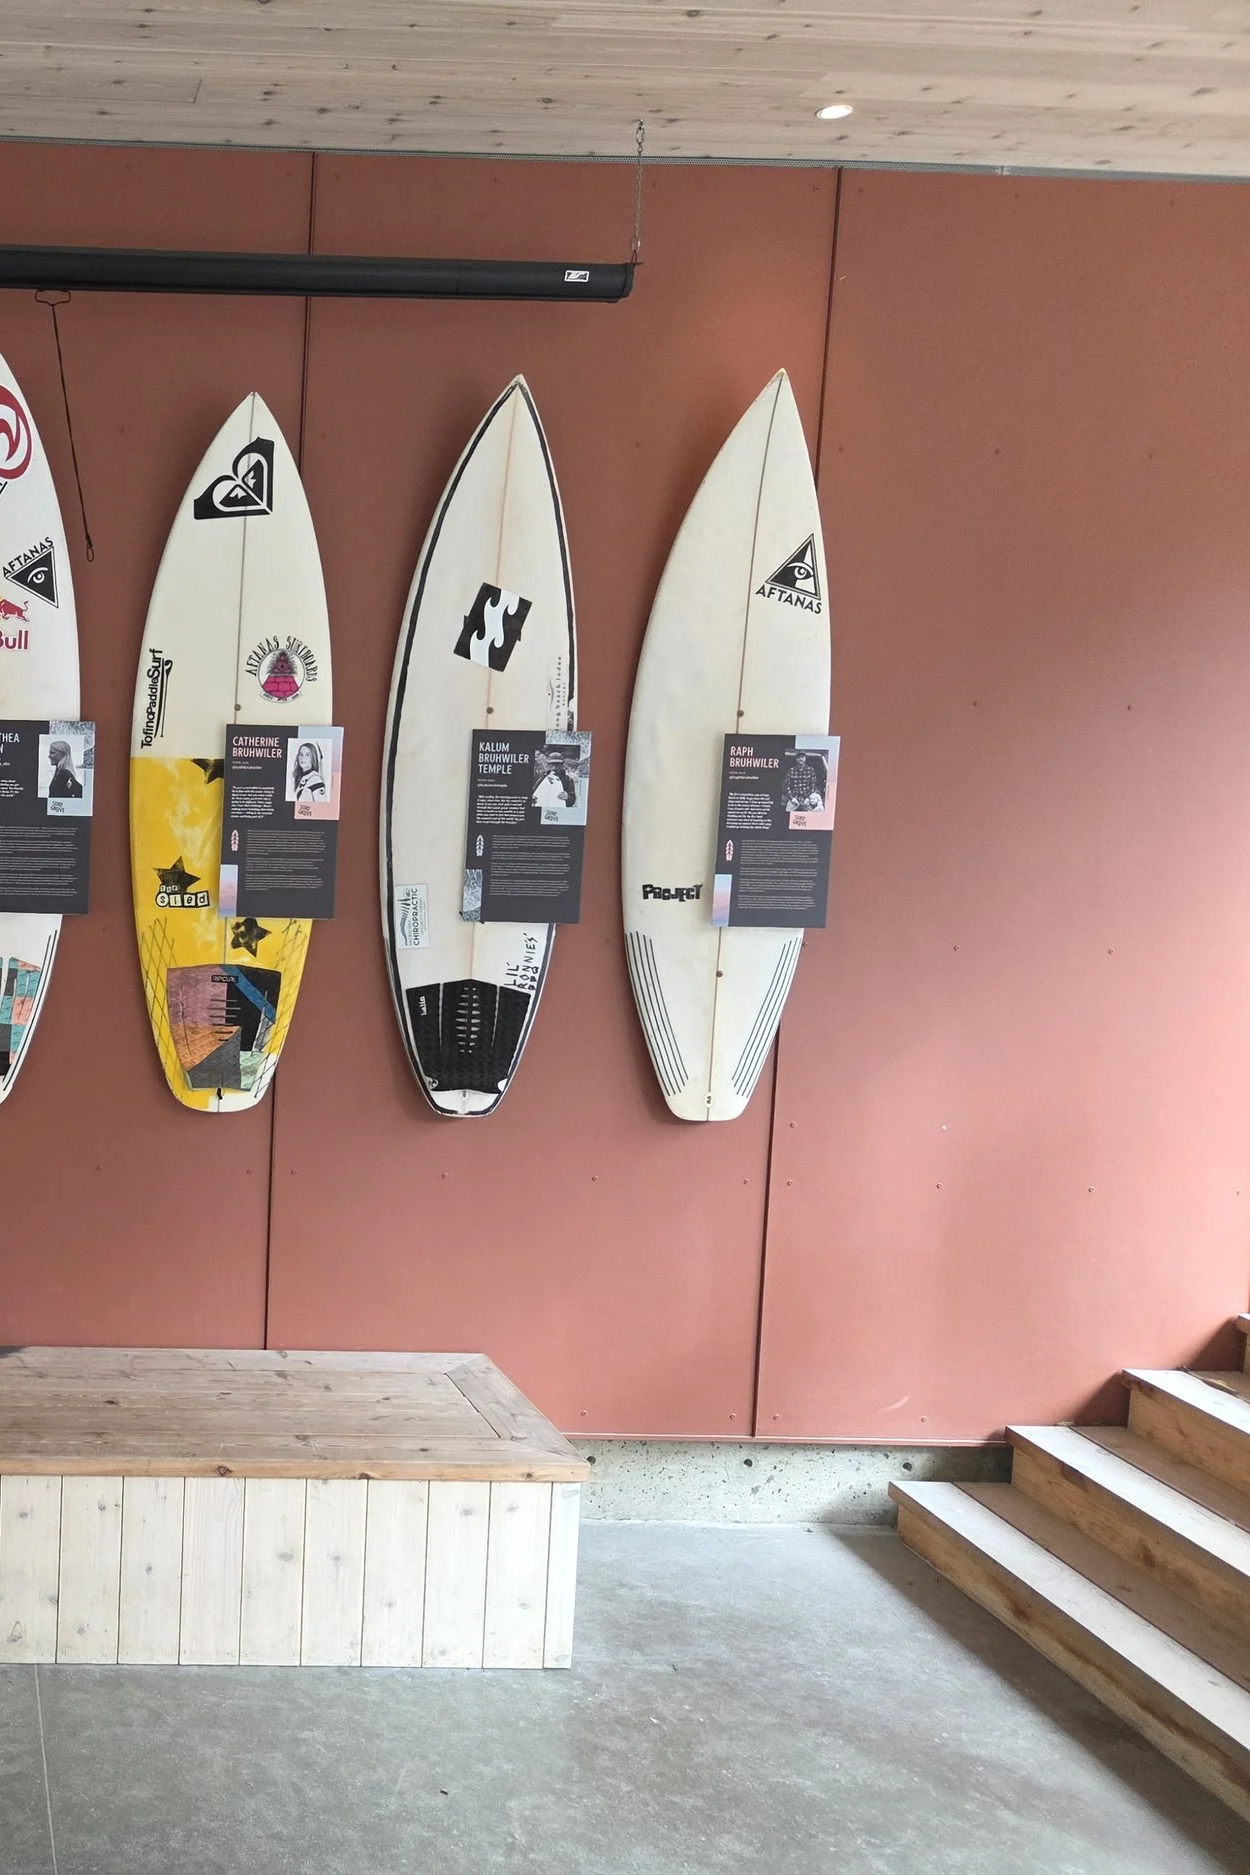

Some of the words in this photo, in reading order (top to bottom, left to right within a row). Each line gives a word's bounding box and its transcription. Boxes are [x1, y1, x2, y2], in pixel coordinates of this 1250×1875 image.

[2, 536, 54, 578] AFTANAS
[755, 583, 822, 615] AFTANAS
[232, 736, 280, 747] CATHERINE
[479, 741, 510, 752] KALUM
[232, 747, 282, 759] BRUHWILER
[730, 746, 754, 757] RAPH
[478, 753, 530, 764] BRUHWILER
[729, 757, 780, 769] BRUHWILER
[478, 764, 512, 775] TEMPLE
[410, 888, 420, 946] CHIROPRACTIC
